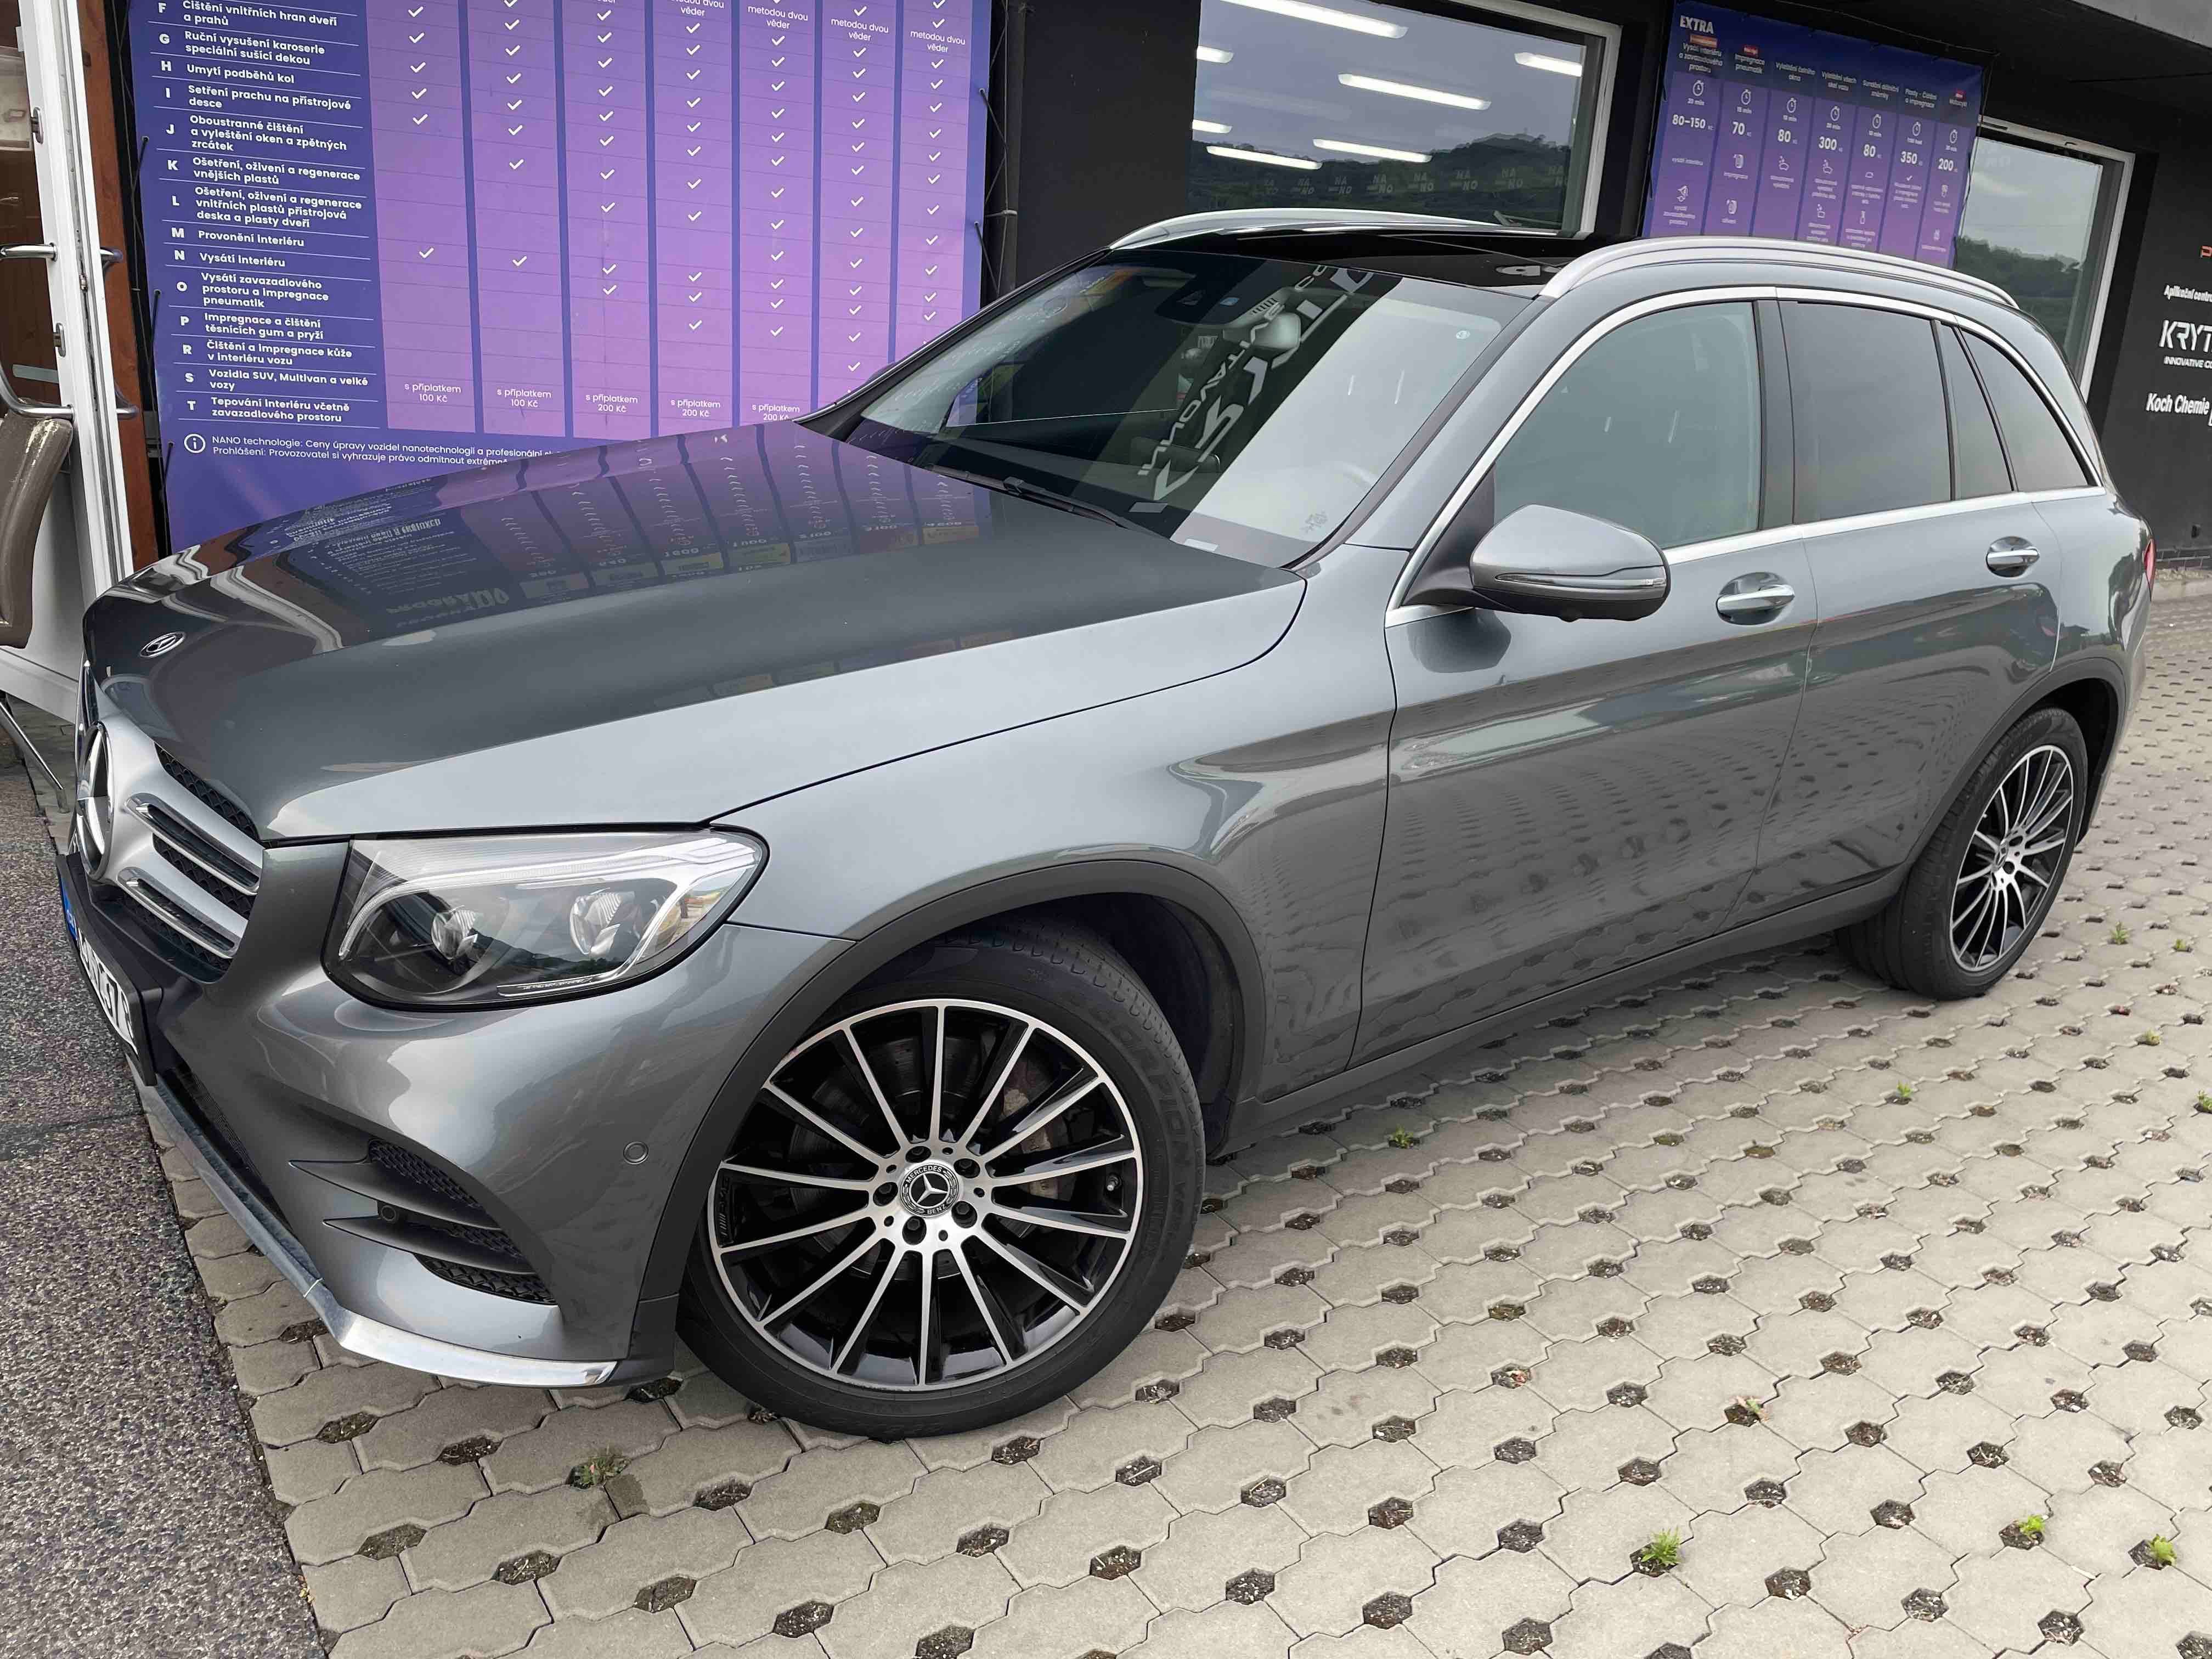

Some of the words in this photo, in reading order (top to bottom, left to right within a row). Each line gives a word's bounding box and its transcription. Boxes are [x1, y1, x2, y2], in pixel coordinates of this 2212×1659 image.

[159, 3, 166, 13] F
[681, 7, 705, 16] věder
[748, 6, 786, 18] metodou
[788, 11, 808, 21] dvou
[195, 15, 228, 25] prahů
[225, 6, 276, 18] vnitřních
[280, 11, 306, 22] hran
[309, 15, 336, 26] dveří
[767, 19, 790, 29] věder
[831, 18, 867, 30] metodou
[869, 22, 889, 33] dvou
[1680, 15, 1714, 34] EXTRA
[160, 34, 170, 44] G
[185, 31, 216, 42] Ruční
[219, 36, 269, 48] vysušení
[273, 40, 325, 54] karoserie
[849, 31, 871, 41] věder
[910, 31, 945, 42] metodou
[947, 36, 966, 45] dvou
[927, 43, 948, 53] věder
[185, 45, 237, 57] speciální
[240, 50, 272, 60] sušící
[275, 53, 310, 65] dekou
[161, 60, 171, 71] H
[187, 64, 221, 77] Umytí
[224, 70, 274, 81] podběhů
[278, 74, 294, 83] kol
[166, 88, 170, 98] I
[189, 85, 228, 97] Setření
[232, 91, 271, 101] prachu
[292, 95, 351, 110] přístrojové
[189, 97, 222, 108] desce
[166, 124, 174, 134] J
[190, 115, 263, 129] Oboustranné
[267, 122, 303, 134] čištění
[1733, 121, 1745, 135] 70
[201, 129, 252, 141] vyleštění
[256, 134, 283, 144] oken
[296, 138, 347, 151] zpětných
[1778, 129, 1791, 143] 80
[192, 139, 234, 151] zrcátek
[1819, 136, 1837, 150] 300
[1864, 144, 1876, 157] 80
[1900, 151, 1917, 165] 350
[1938, 158, 1954, 171] 200
[168, 160, 178, 170] K
[193, 157, 242, 171] Ošetření,
[246, 162, 285, 173] oživení
[298, 168, 360, 180] regenerace
[194, 170, 240, 181] vnějších
[244, 174, 279, 184] plastů
[172, 196, 179, 206] L
[195, 187, 245, 200] Ošetření,
[248, 191, 286, 202] oživení
[301, 198, 362, 208] regenerace
[196, 199, 246, 211] vnitřních
[250, 204, 284, 214] plastů
[288, 206, 346, 219] přístrojová
[197, 211, 230, 221] deska
[245, 215, 279, 228] plasty
[282, 218, 309, 227] dveří
[172, 228, 184, 238] M
[199, 230, 254, 242] Provonění
[257, 234, 304, 246] interiéru
[174, 250, 184, 260] N
[200, 253, 235, 263] Vysátí
[238, 255, 285, 267] interiéru
[177, 282, 187, 291] O
[201, 273, 236, 283] Vysátí
[240, 276, 321, 289] zavazadlového
[202, 285, 249, 295] prostoru
[263, 288, 329, 301] impregnace
[204, 297, 264, 307] pneumatik
[180, 316, 189, 325] P
[205, 313, 272, 325] Impregnace
[285, 318, 320, 328] čištění
[206, 325, 255, 335] těsnících
[259, 329, 284, 338] gum
[297, 331, 323, 341] pryží
[2159, 320, 2212, 352] KRYT
[183, 345, 191, 354] R
[207, 339, 245, 351] Čištění
[259, 343, 324, 356] impregnace
[328, 348, 352, 357] kůže
[218, 352, 264, 363] interiéru
[2164, 356, 2204, 368] INNOVATIVE
[185, 373, 194, 382] S
[209, 369, 249, 379] Vozidla
[253, 372, 276, 382] SUV,
[280, 373, 326, 383] Multivan
[340, 376, 368, 385] velké
[210, 382, 235, 391] vozy
[412, 383, 461, 394] příplatkem
[504, 388, 551, 398] příplatkem
[187, 400, 196, 410] T
[211, 397, 261, 408] Tepování
[265, 399, 311, 409] interiéru
[314, 403, 349, 411] včetně
[419, 394, 434, 402] 100
[437, 394, 448, 403] Kč
[527, 399, 539, 408] Kč
[592, 394, 638, 404] příplatkem
[678, 399, 721, 409] příplatkem
[2146, 392, 2173, 413] Koch
[2174, 394, 2210, 415] Chemie
[699, 409, 710, 417] Kč
[759, 404, 800, 413] příplatkem
[212, 410, 294, 420] zavazadlového
[297, 414, 341, 422] prostoru
[212, 436, 241, 444] NANO
[244, 437, 303, 449] technologie:
[306, 439, 330, 450] Ceny
[333, 441, 365, 452] úpravy
[403, 445, 475, 456] nanotechnologii
[213, 447, 266, 456] Prohlášení:
[269, 449, 330, 459] Provozovatel
[342, 452, 386, 462] vyhrazuje
[389, 454, 415, 463] právo
[418, 455, 465, 464] odmítnout
[905, 1164, 943, 1183] MERCEDES
[927, 1204, 947, 1215] BENZ
